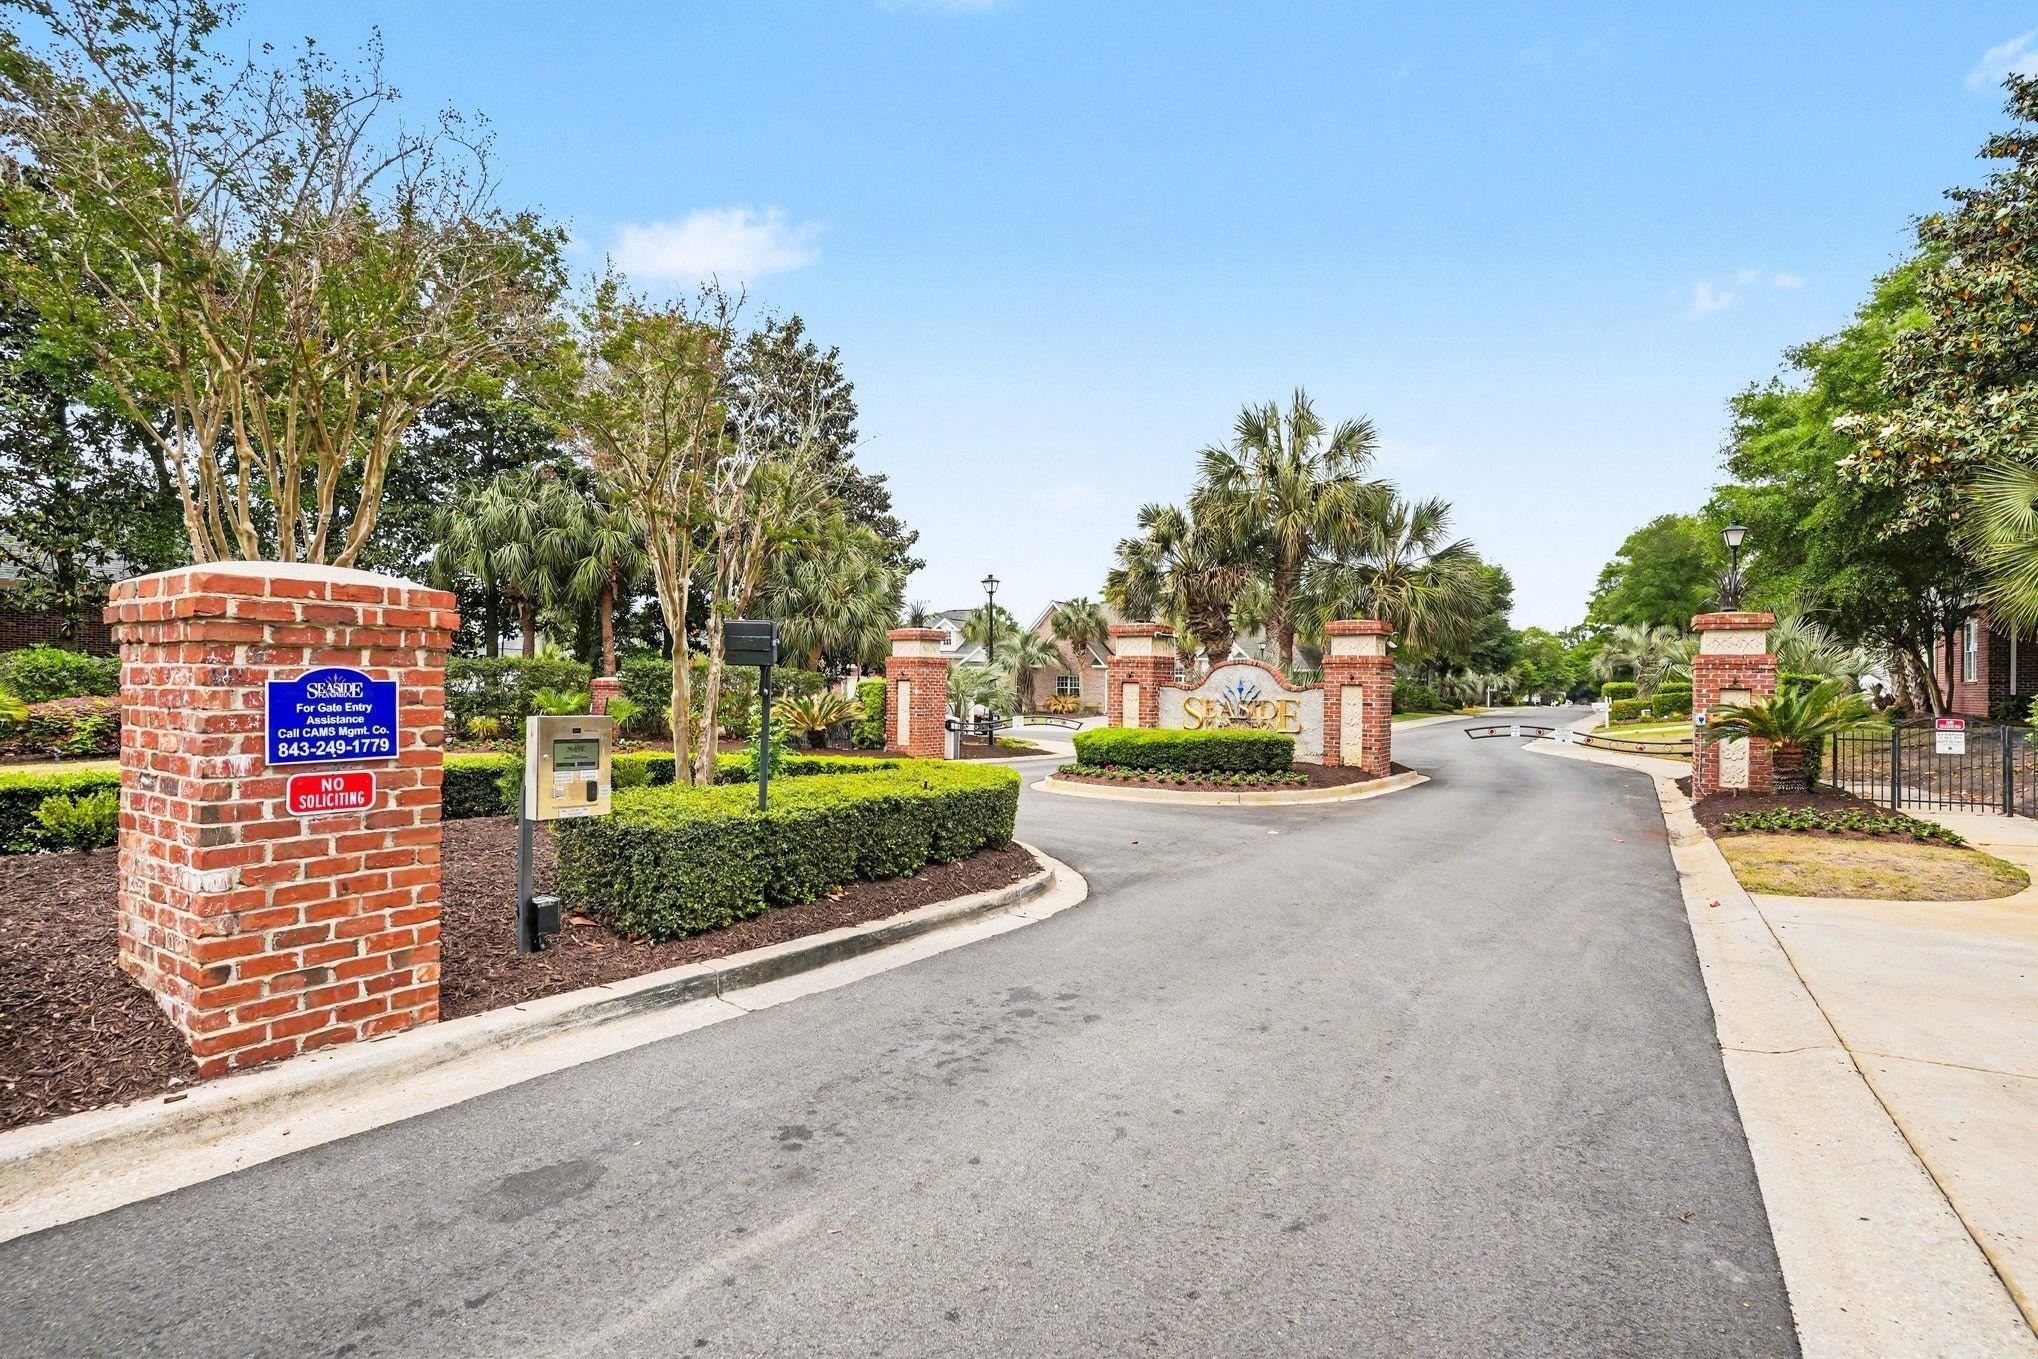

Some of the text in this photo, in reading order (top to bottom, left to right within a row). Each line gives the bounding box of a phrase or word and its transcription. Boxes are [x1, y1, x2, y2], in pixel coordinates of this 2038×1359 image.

[306, 682, 363, 699] SEASIDE
[296, 702, 372, 713] For Gate Entry
[1183, 697, 1301, 734] SEASIDE
[306, 715, 364, 725] Assistance
[278, 725, 389, 739] Call CAMS Mgmt. Co.
[278, 738, 389, 757] 843-249-1779
[321, 777, 344, 792] NO
[299, 791, 365, 809] SOLICITING
